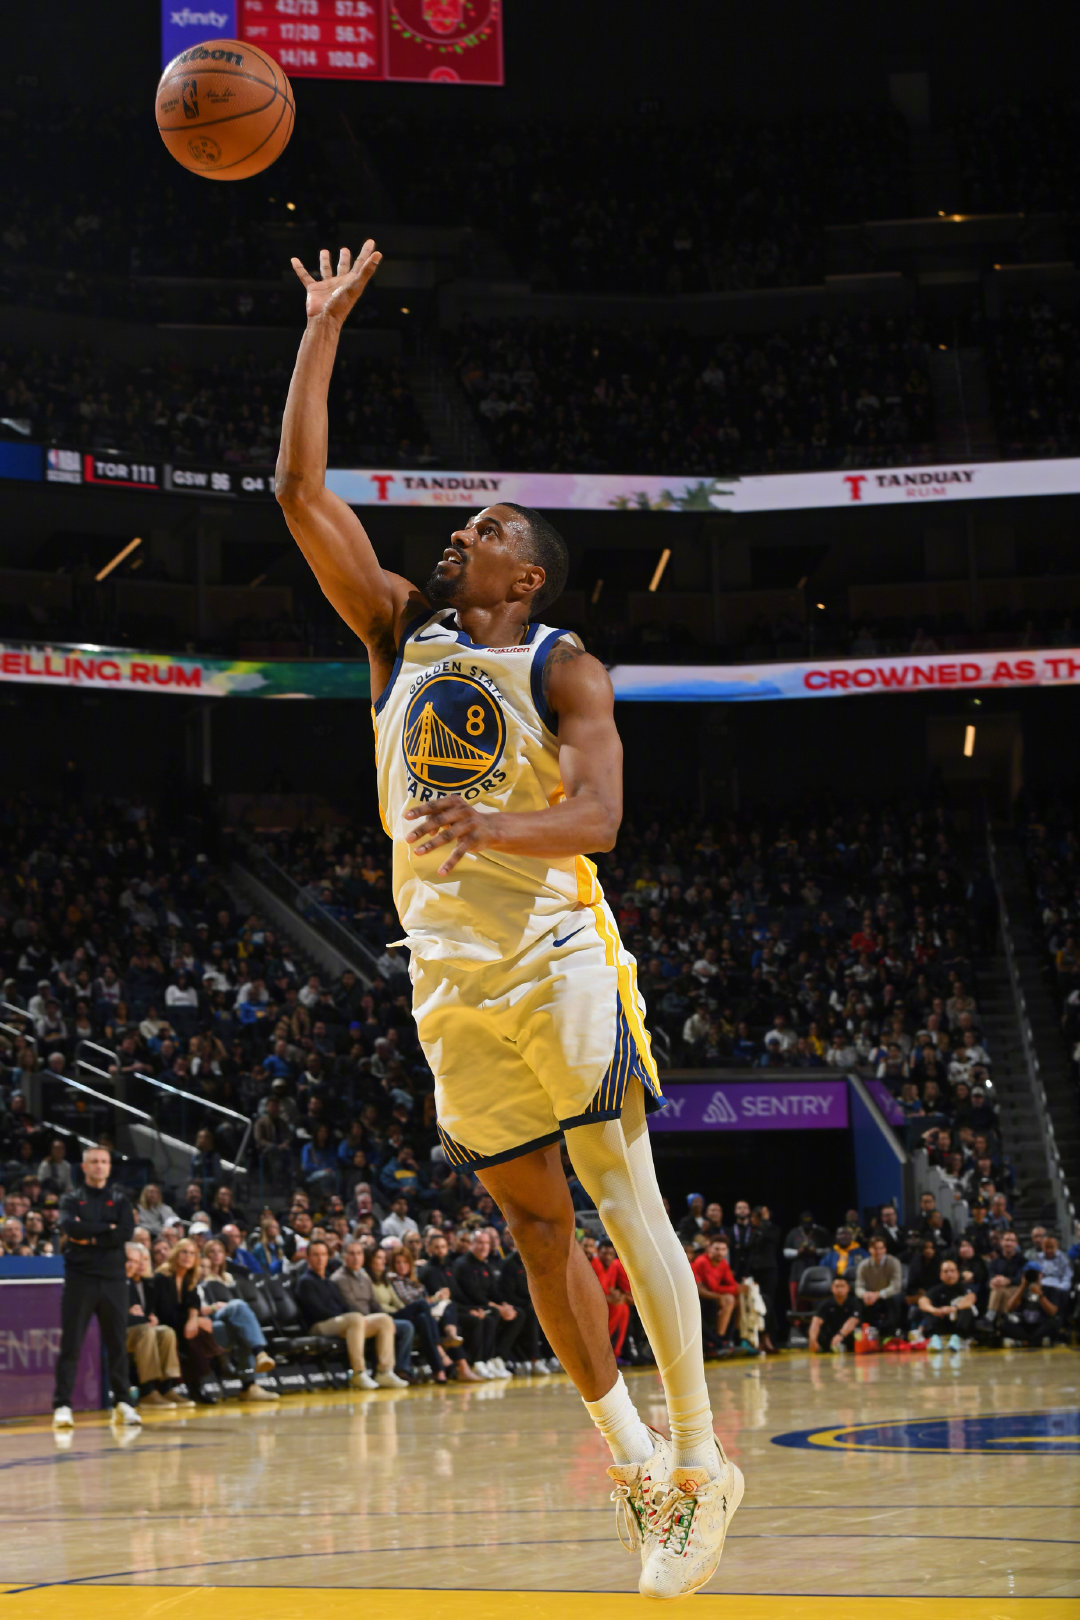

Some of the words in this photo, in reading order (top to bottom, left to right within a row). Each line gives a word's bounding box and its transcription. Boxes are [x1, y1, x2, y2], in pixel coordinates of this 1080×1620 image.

[171, 8, 228, 28] xfinity
[280, 24, 320, 41] 17/30
[280, 49, 318, 65] 14/14
[95, 461, 128, 478] TOR
[131, 465, 156, 483] 111
[173, 471, 208, 487] GSW
[241, 476, 265, 491] Q4
[875, 470, 976, 487] TANDUAY
[403, 477, 501, 491] TANDUAY
[906, 487, 947, 498] RUM
[432, 493, 473, 502] RUM
[130, 662, 201, 688] RUM
[409, 661, 462, 694] GOLDEN
[469, 665, 506, 702] STATE
[804, 663, 982, 690] CROWNED
[993, 660, 1036, 682] AS
[466, 705, 485, 735] 8
[406, 769, 507, 802] ARORS
[741, 1096, 834, 1117] SENTRY
